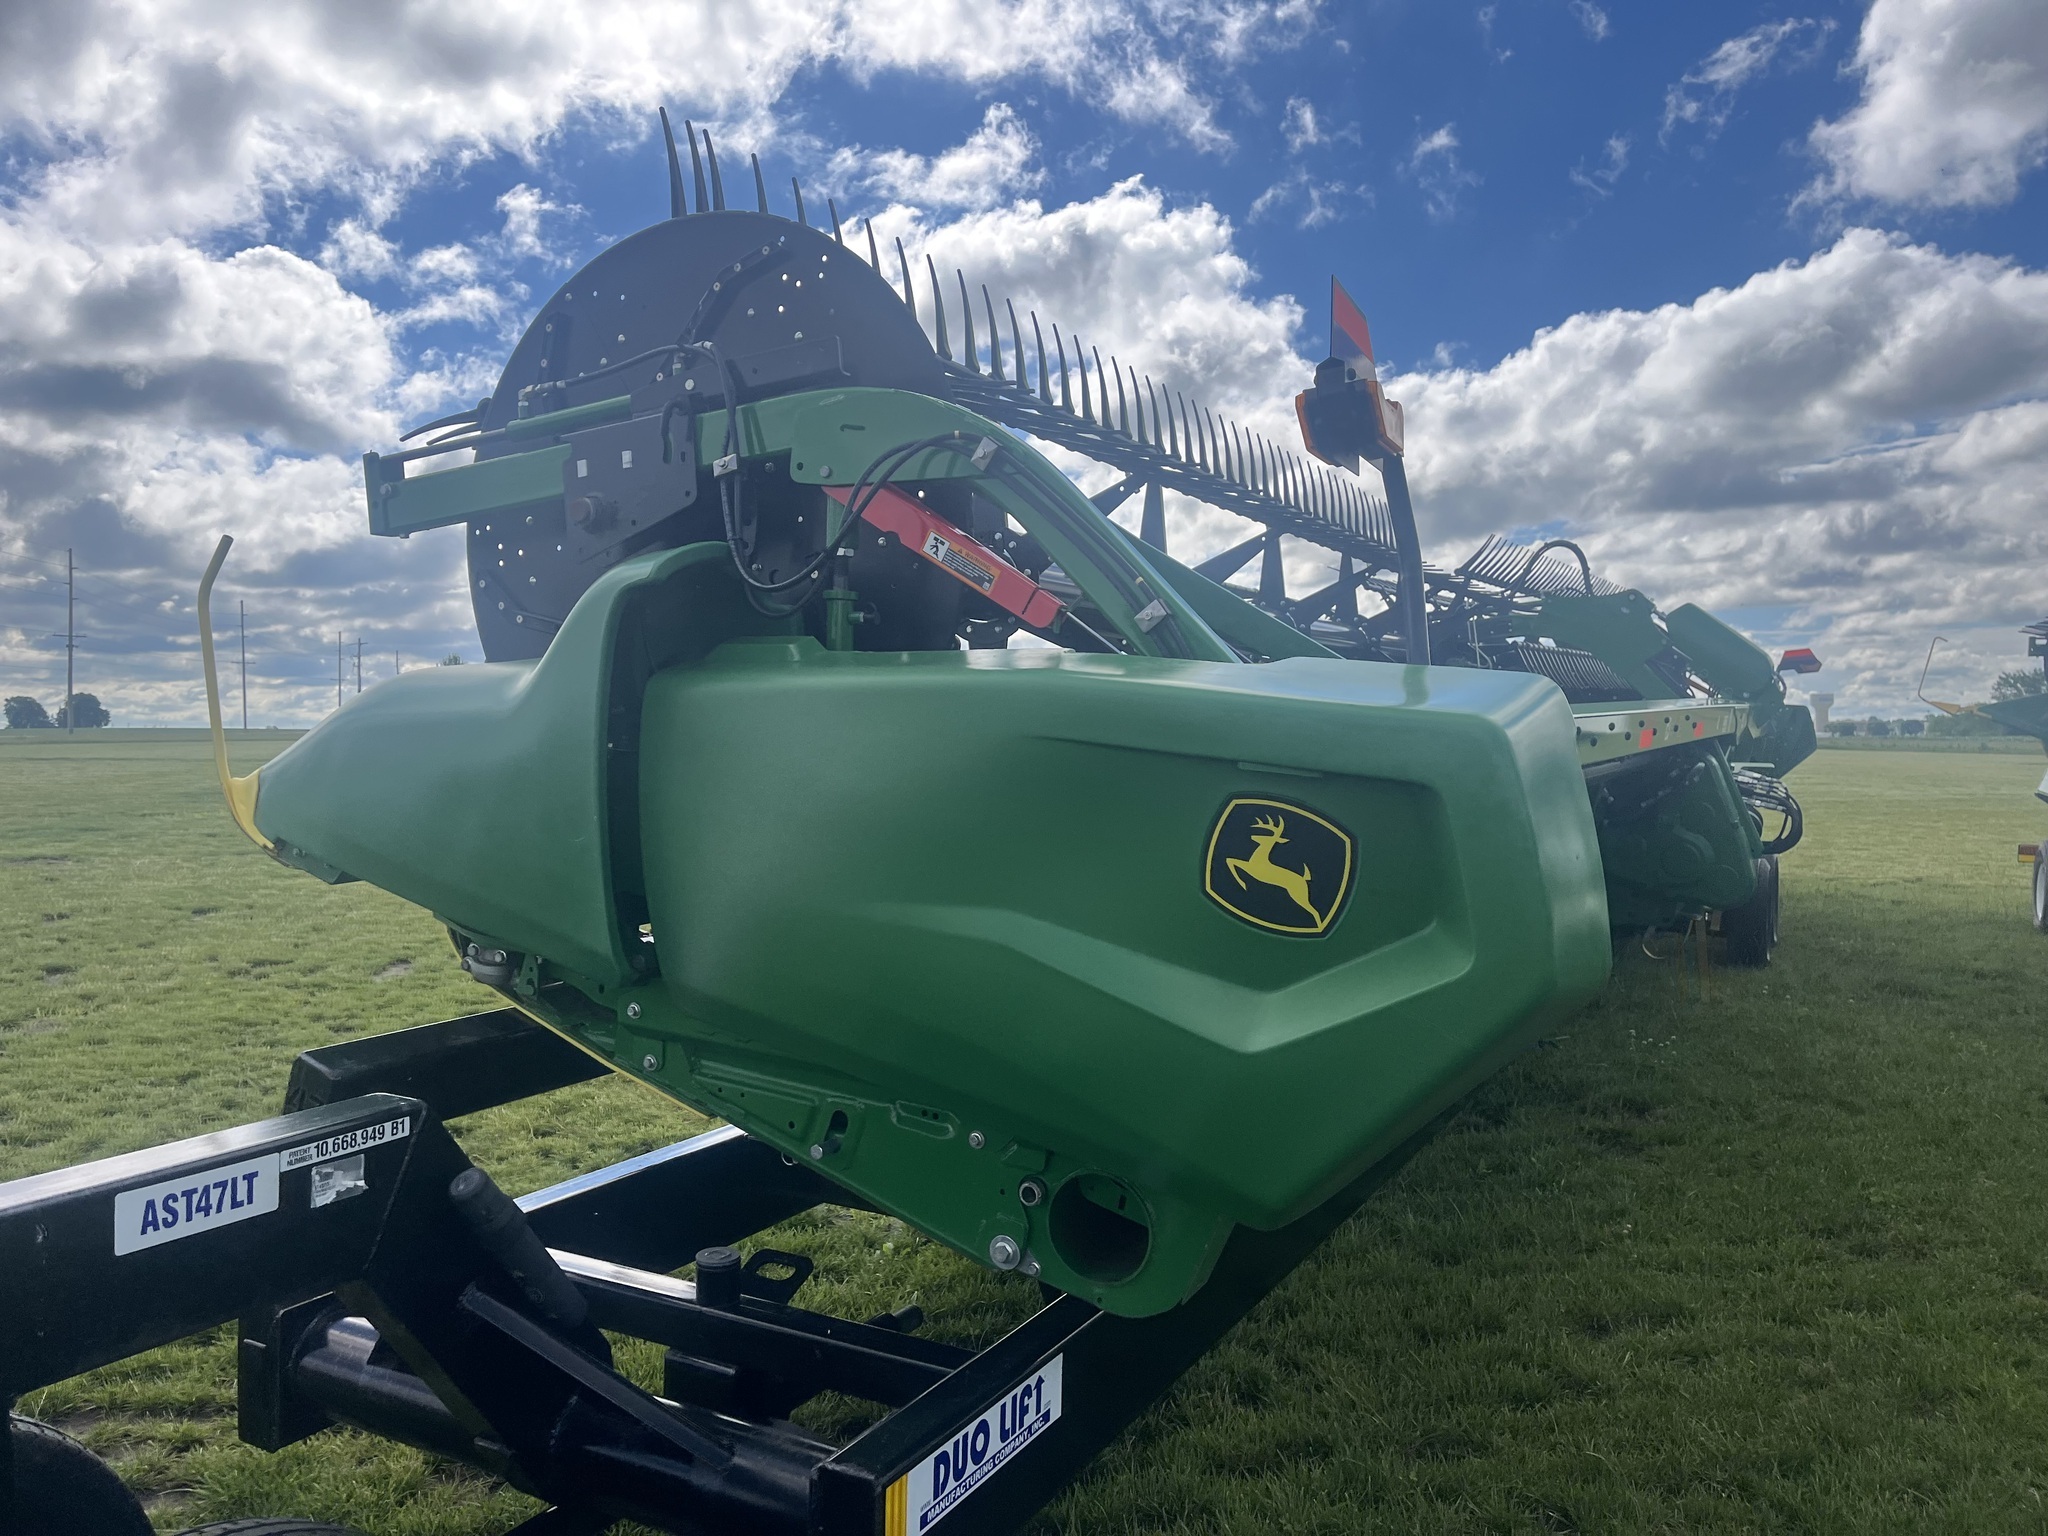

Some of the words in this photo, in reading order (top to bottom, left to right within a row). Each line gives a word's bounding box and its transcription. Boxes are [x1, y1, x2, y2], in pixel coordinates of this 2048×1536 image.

[964, 552, 992, 571] WARNING
[289, 1146, 312, 1159] PATENT
[314, 1125, 385, 1158] 10,668,949
[391, 1119, 405, 1137] B1
[140, 1171, 259, 1236] AST47LT
[932, 1418, 991, 1502] DUO
[1000, 1374, 1045, 1444] LIFT
[926, 1459, 994, 1523] MANUFACTURING
[1031, 1416, 1045, 1435] INC.
